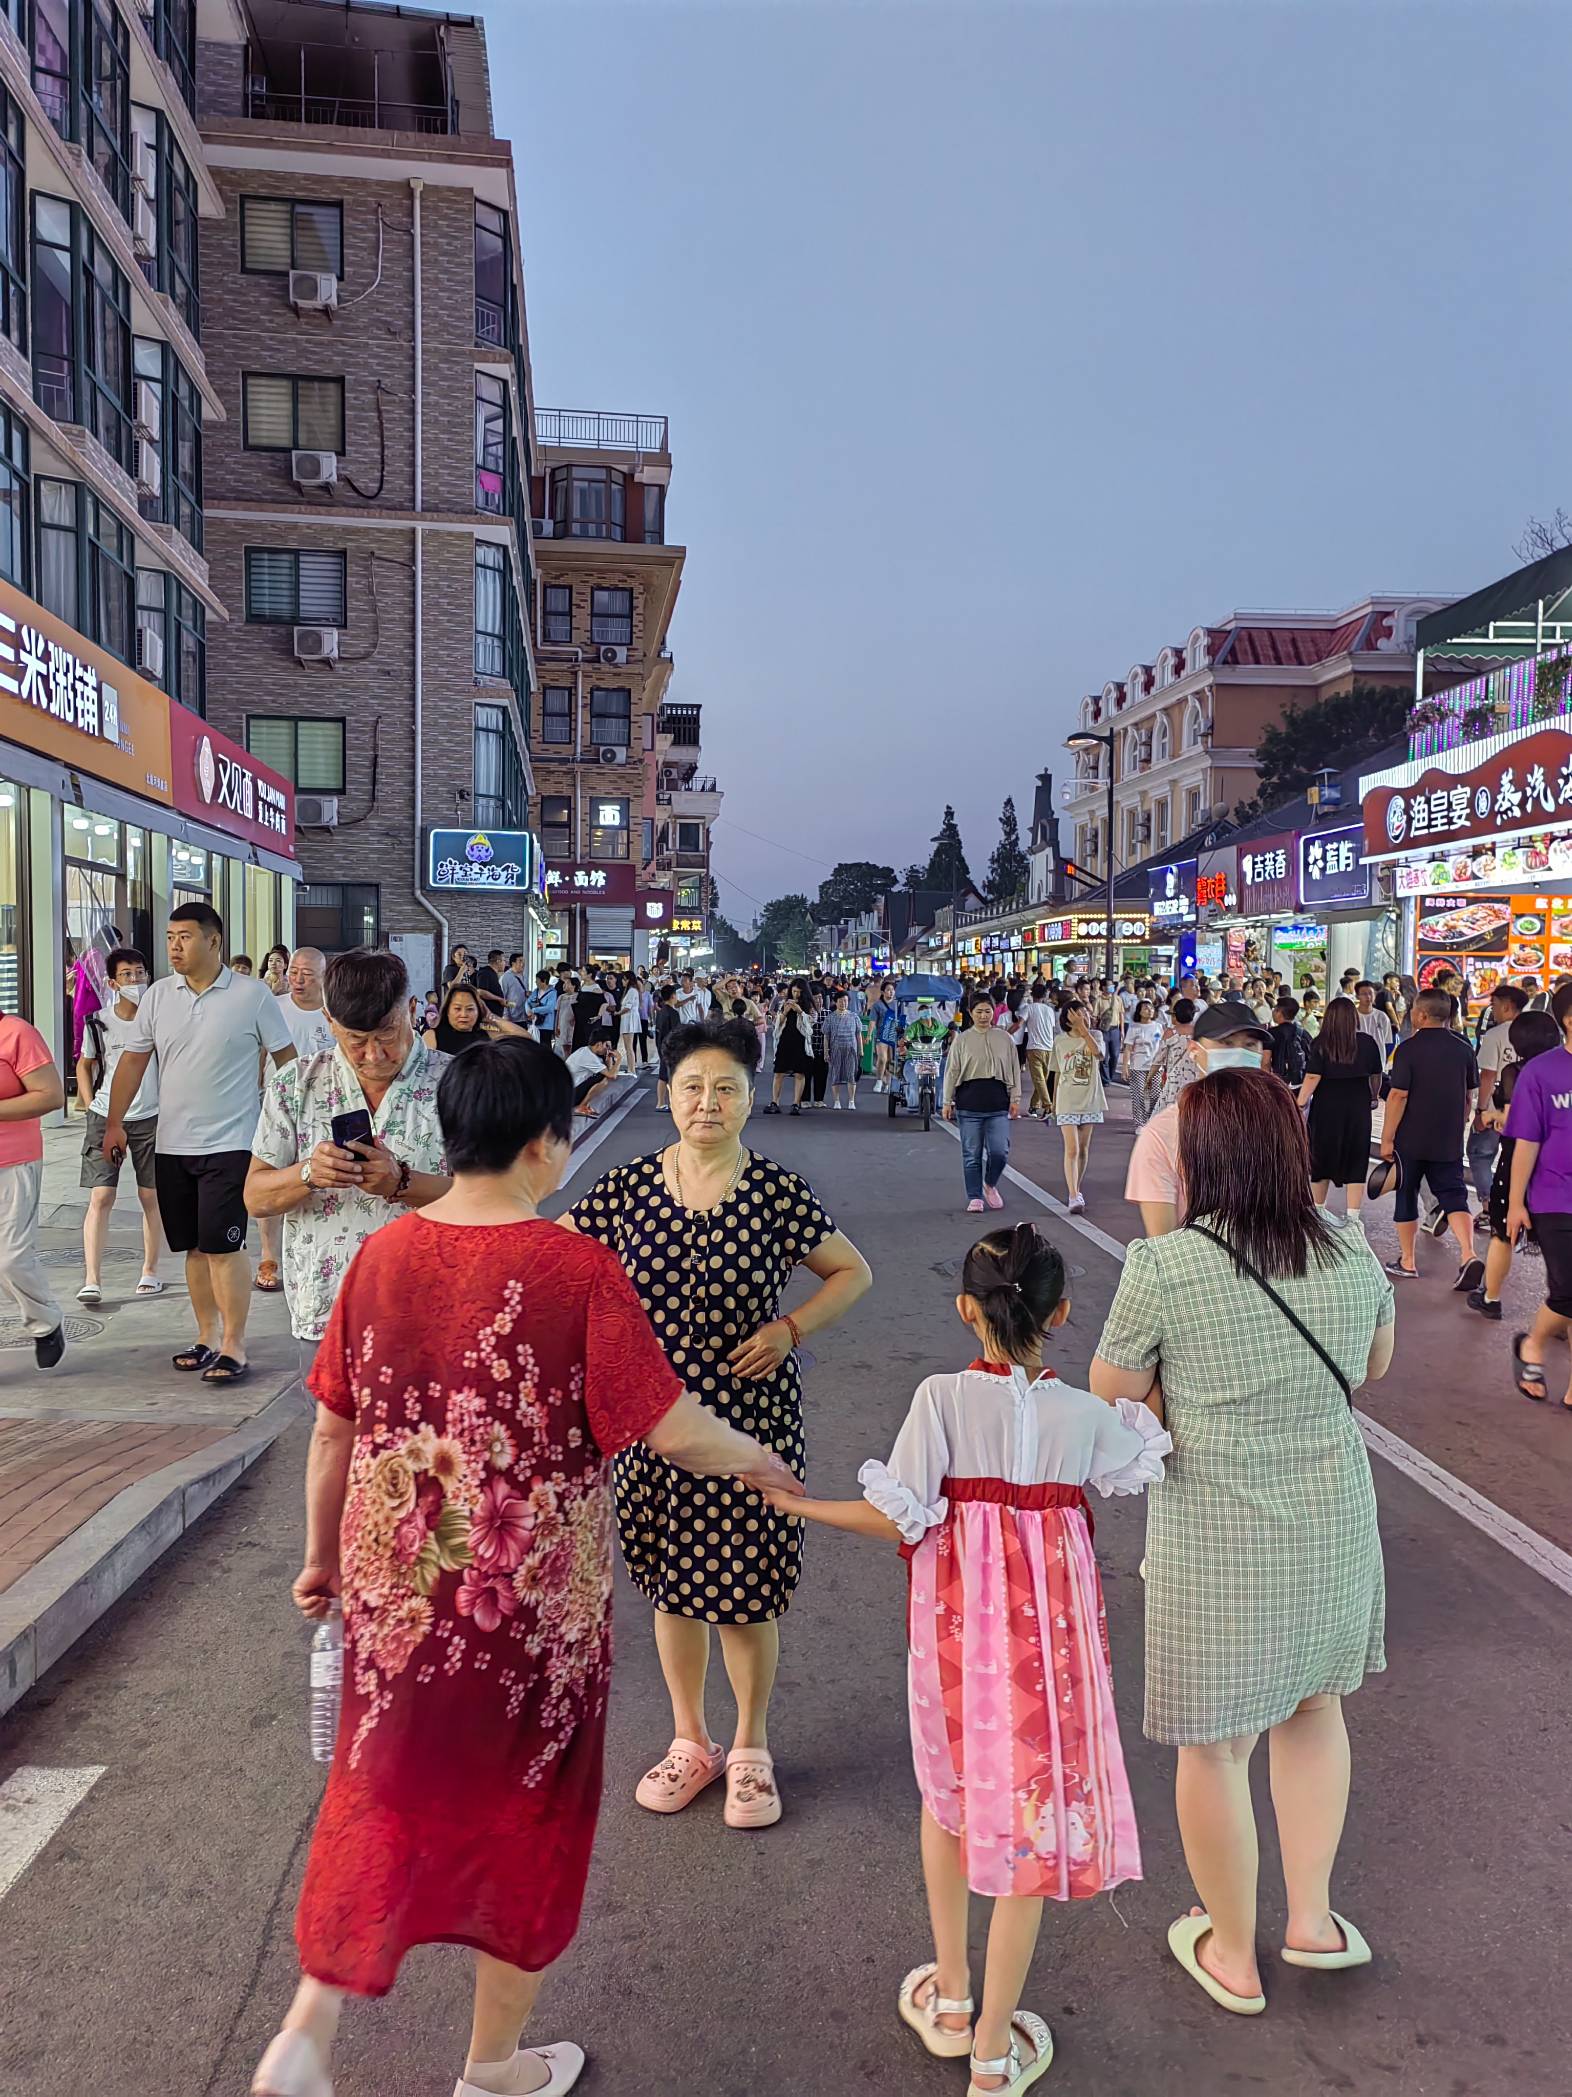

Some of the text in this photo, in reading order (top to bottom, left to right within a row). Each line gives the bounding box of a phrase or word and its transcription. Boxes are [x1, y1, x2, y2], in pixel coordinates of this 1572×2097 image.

[217, 753, 253, 819] 又见面
[1409, 784, 1472, 838] 渔皇宴
[598, 804, 621, 826] 面
